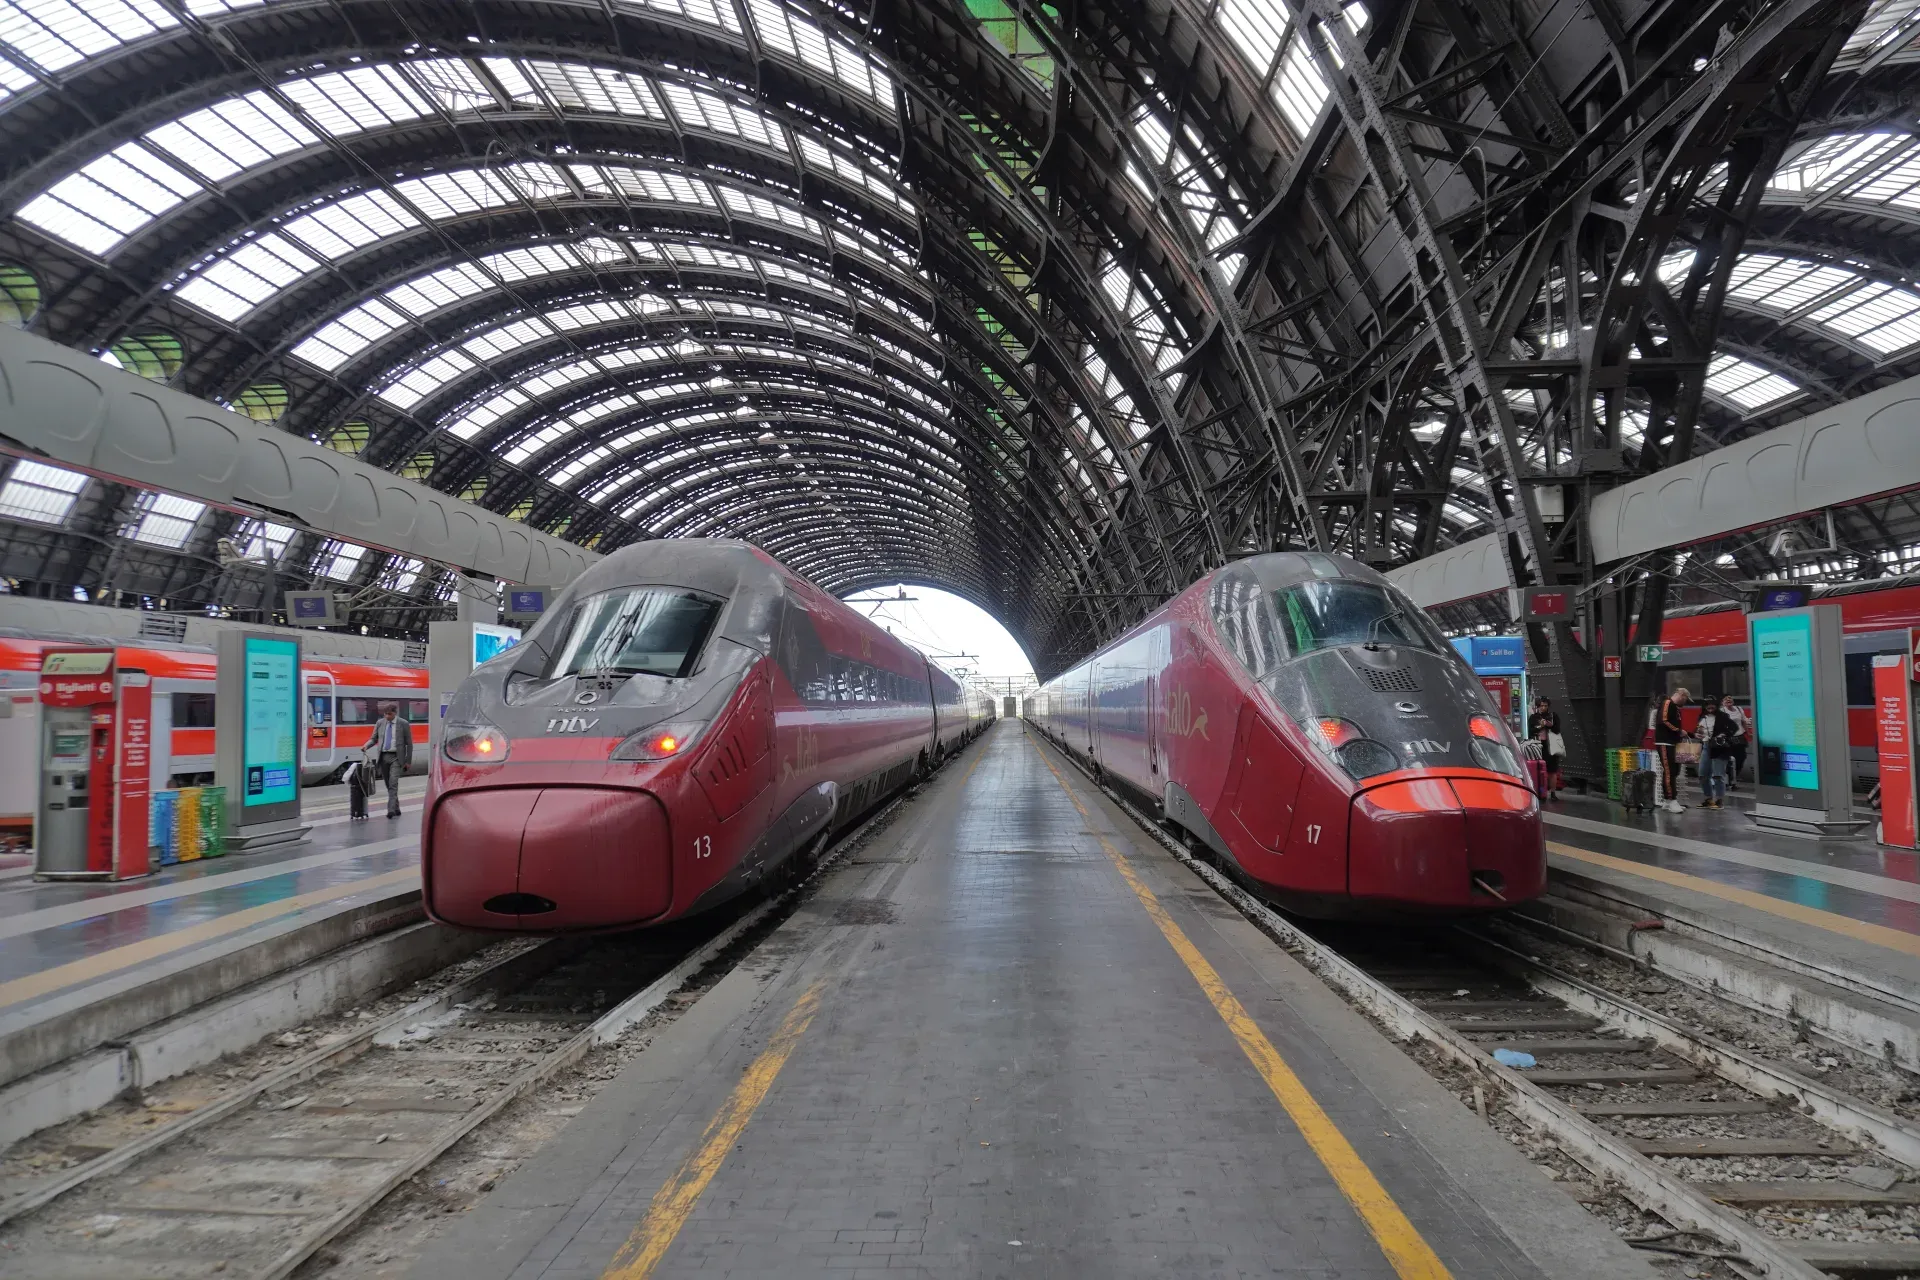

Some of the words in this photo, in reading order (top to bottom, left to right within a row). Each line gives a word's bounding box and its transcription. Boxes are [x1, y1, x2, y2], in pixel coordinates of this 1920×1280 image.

[56, 682, 98, 694] Biglietti
[546, 716, 599, 733] ntv
[1399, 738, 1451, 757] ntv
[1307, 824, 1321, 845] 17
[693, 835, 711, 859] 13
